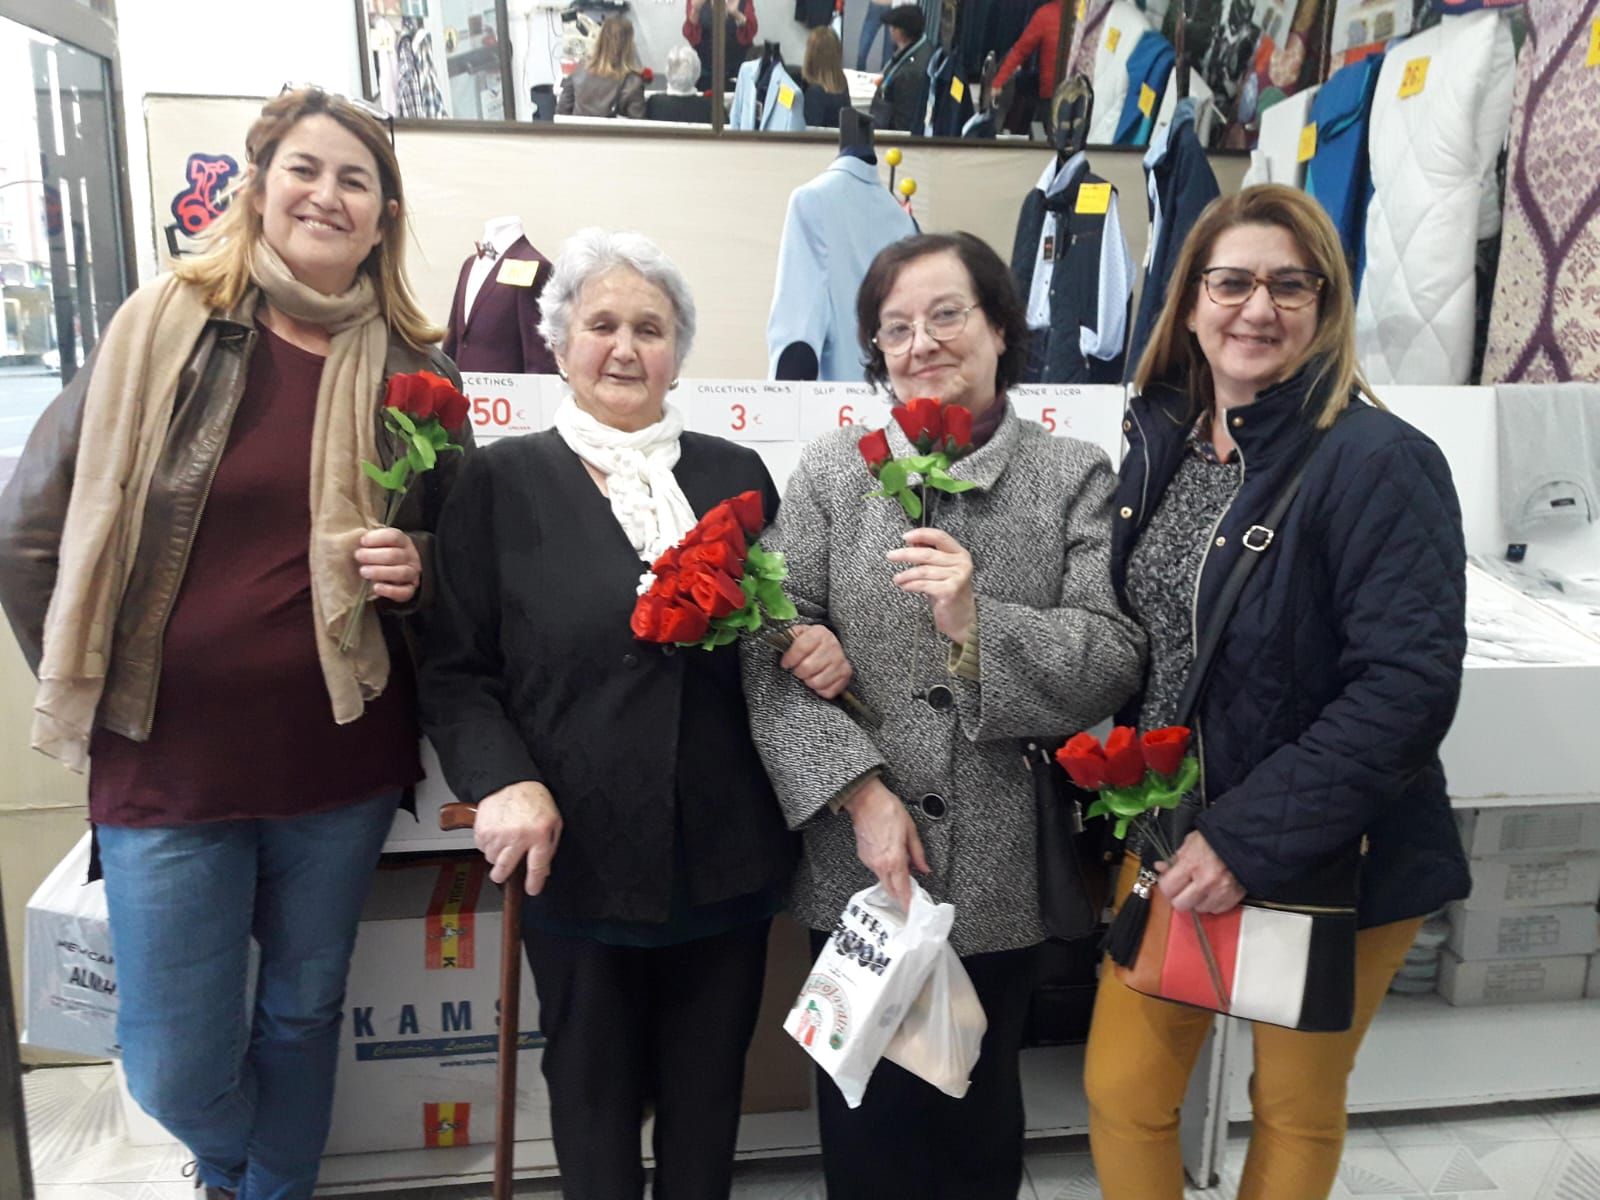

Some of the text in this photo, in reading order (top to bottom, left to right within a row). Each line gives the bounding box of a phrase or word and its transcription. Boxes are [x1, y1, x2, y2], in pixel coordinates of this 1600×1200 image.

[463, 377, 514, 386] CETINES
[697, 385, 757, 393] CALCETINES
[813, 387, 835, 395] SLIP
[731, 404, 746, 430] 3
[838, 405, 854, 427] 6
[1041, 408, 1057, 433] 5
[353, 998, 501, 1038] KAM
